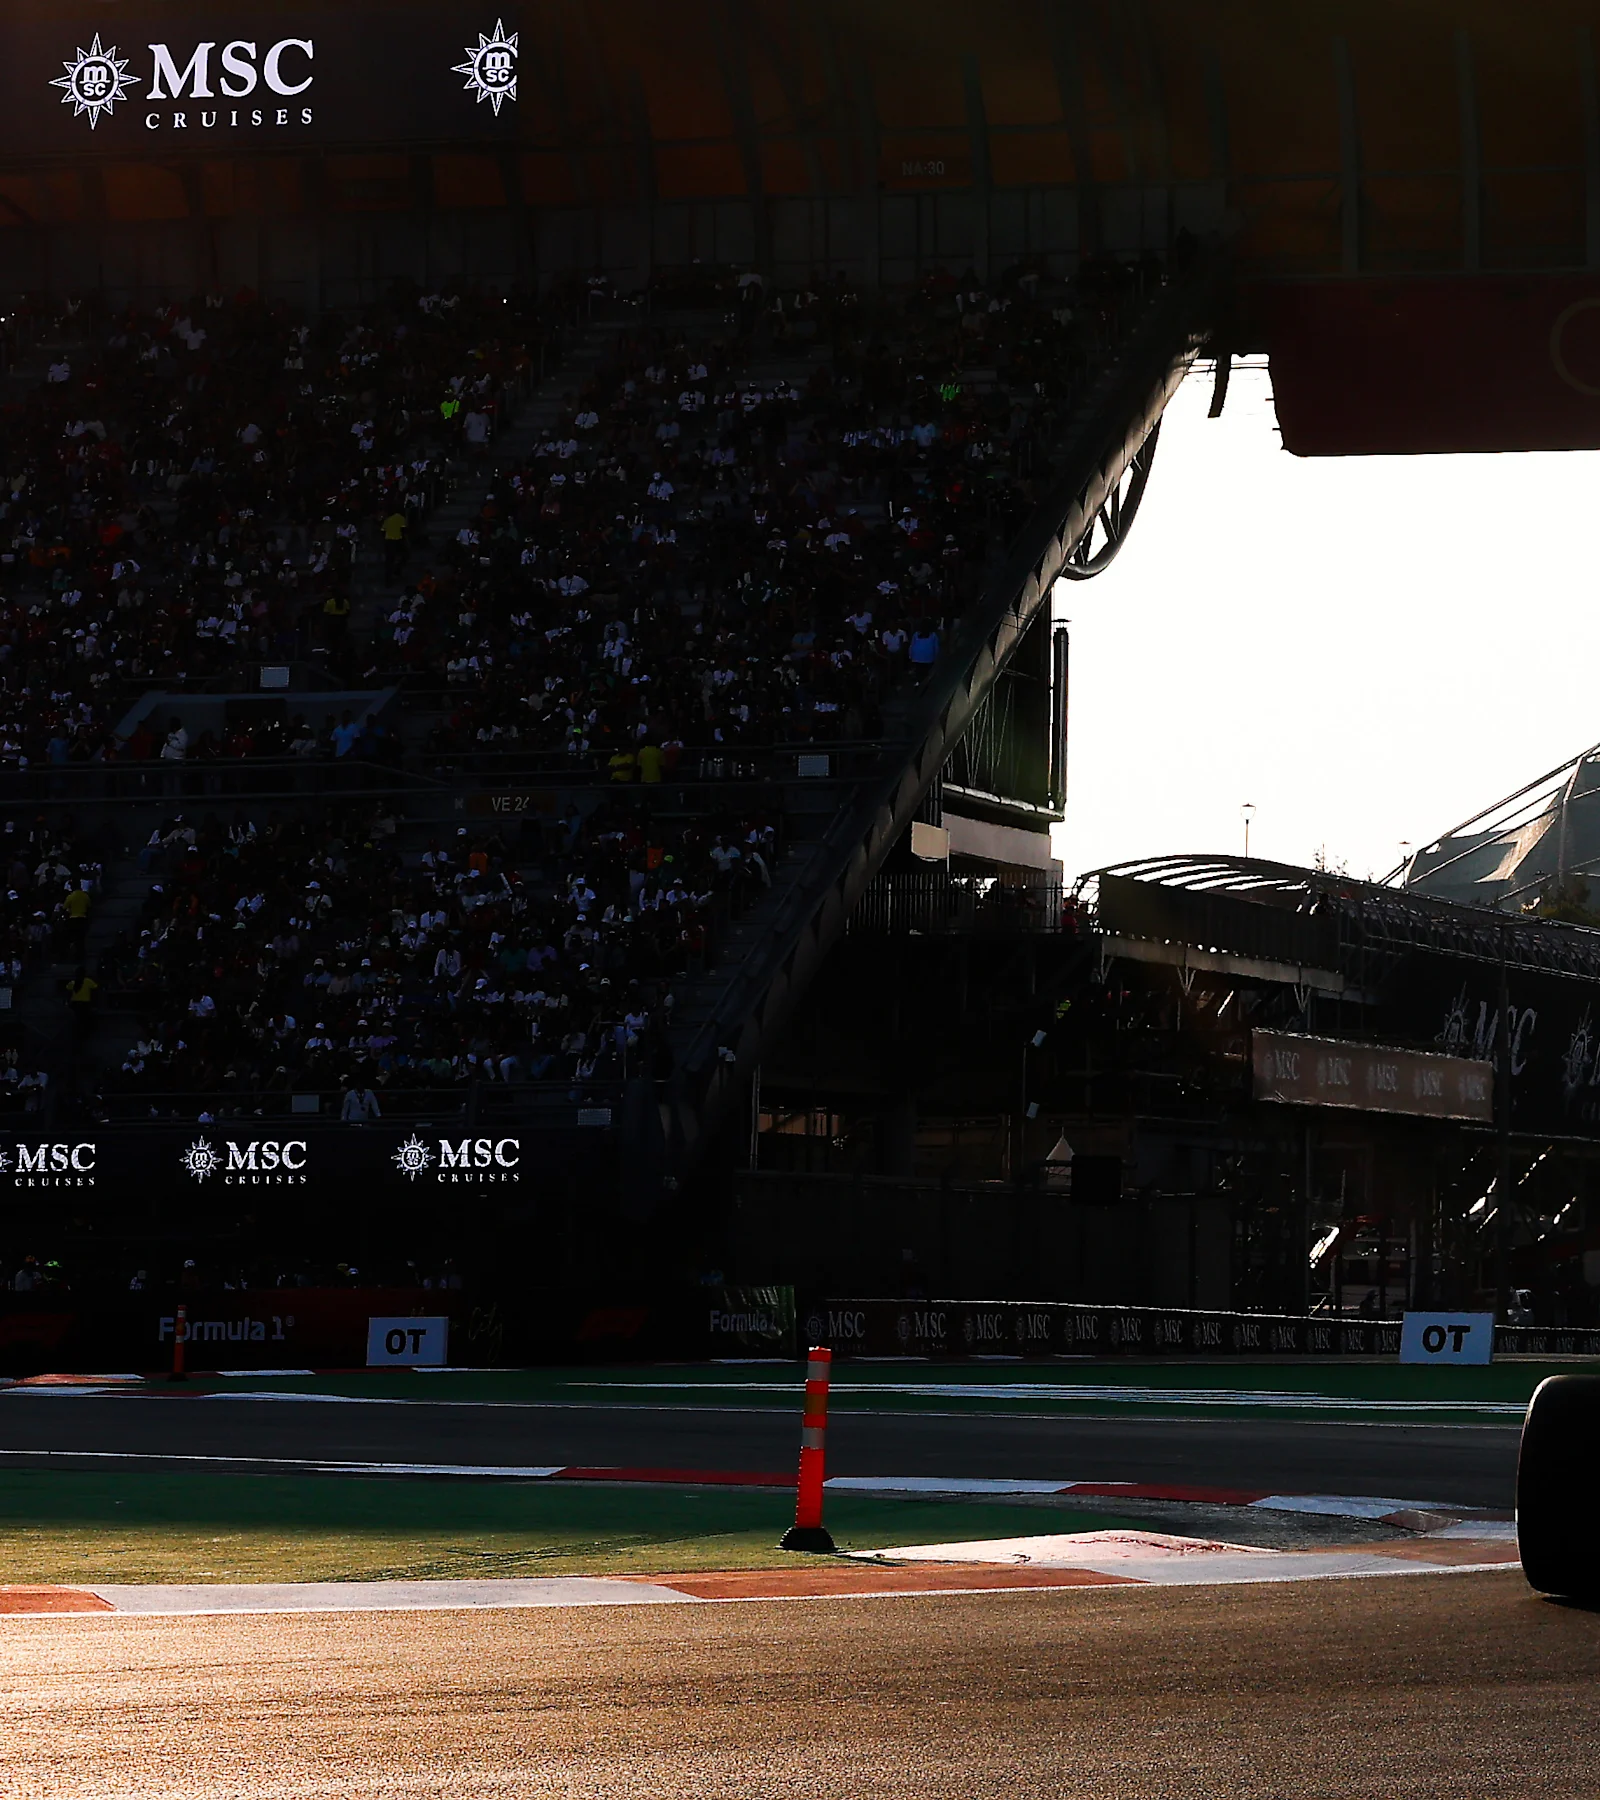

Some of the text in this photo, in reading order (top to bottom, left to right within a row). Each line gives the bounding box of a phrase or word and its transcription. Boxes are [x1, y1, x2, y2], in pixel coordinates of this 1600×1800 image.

[145, 38, 315, 100] MSC
[145, 107, 313, 130] CRUISES
[15, 1142, 96, 1173] MSC
[226, 1140, 308, 1171] MSC
[438, 1138, 520, 1168] MSC
[14, 1176, 96, 1187] CRUISES
[224, 1174, 307, 1185] CRUISES
[437, 1172, 520, 1183] CRUISES
[828, 1311, 866, 1339] MSC
[915, 1311, 948, 1339] MSC
[976, 1313, 1003, 1340] MSC
[1027, 1314, 1051, 1340] MSC
[1075, 1315, 1101, 1341] MSC
[1120, 1316, 1143, 1342] MSC
[1163, 1318, 1184, 1344] MSC
[1202, 1321, 1223, 1346] MSC
[1242, 1322, 1261, 1347] MSC
[1278, 1324, 1297, 1349] MSC
[385, 1329, 427, 1355] OT
[1422, 1325, 1471, 1353] OT
